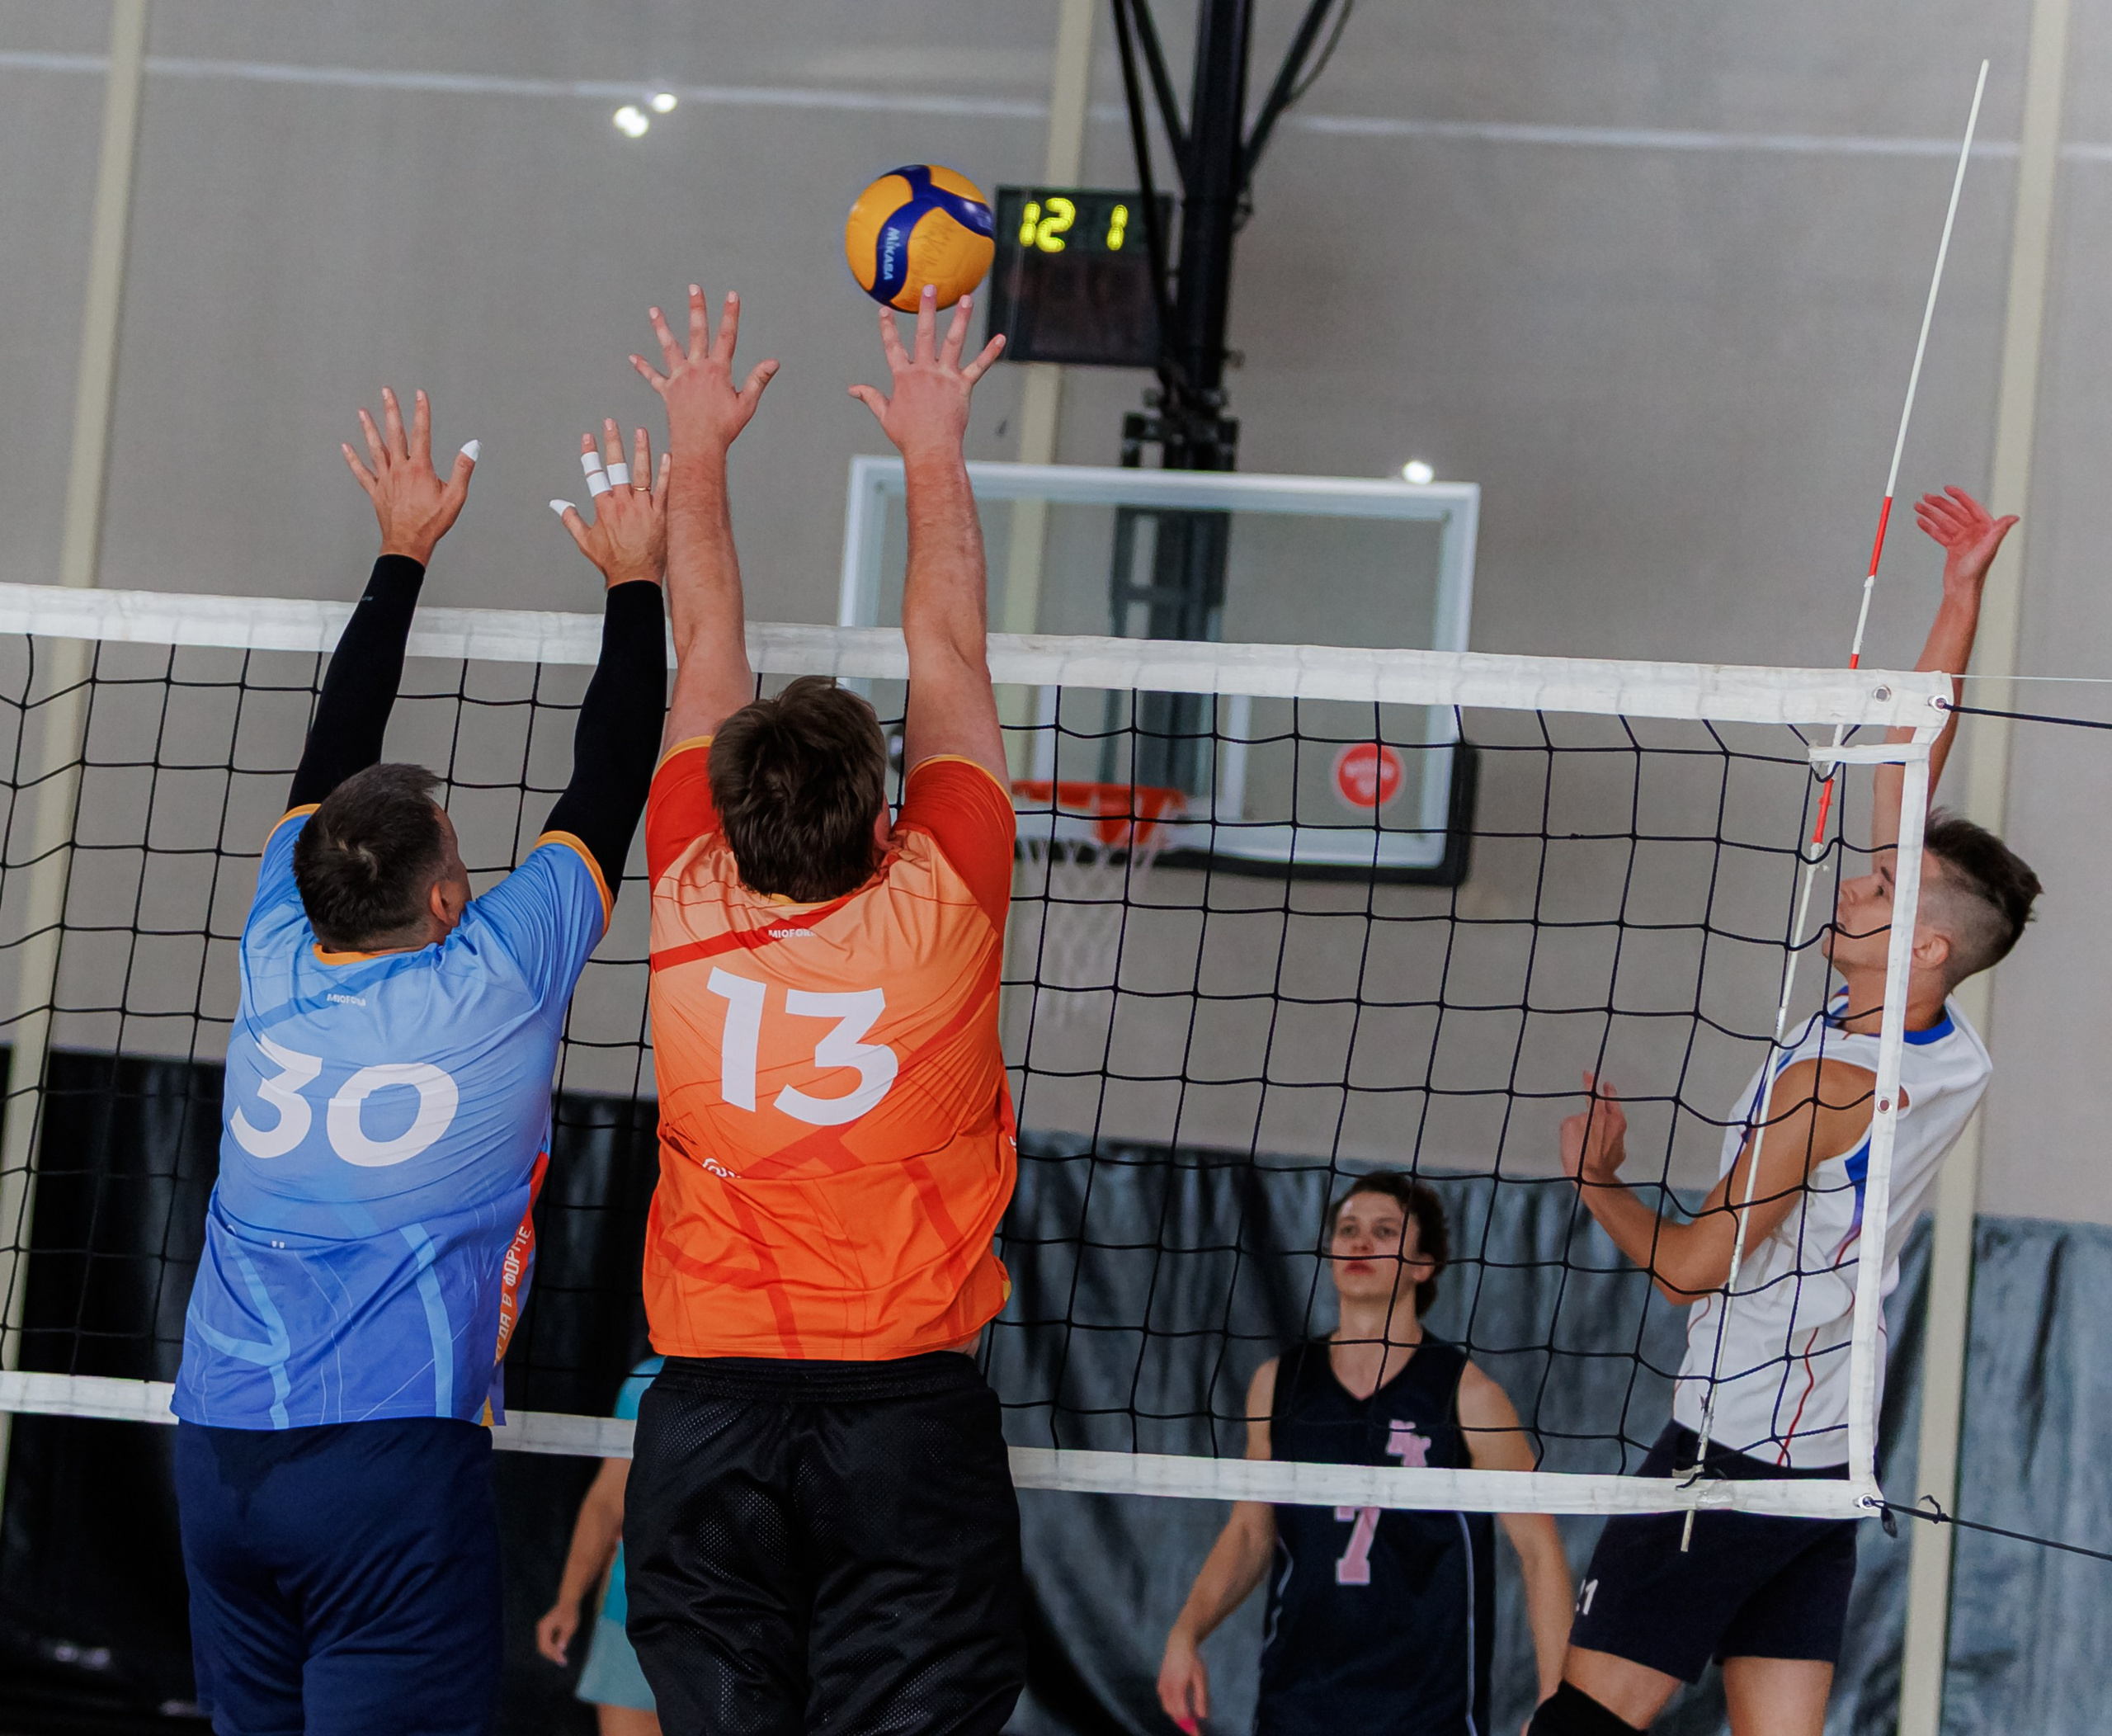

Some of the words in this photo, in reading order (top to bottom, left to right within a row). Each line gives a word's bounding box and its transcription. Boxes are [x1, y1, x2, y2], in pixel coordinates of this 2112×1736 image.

[1019, 197, 1076, 252] 12
[1106, 205, 1129, 251] 1
[706, 966, 898, 1126] 13
[230, 1034, 459, 1168] 30
[503, 1225, 532, 1287] ФОРМЕ
[1333, 1506, 1381, 1586] 7
